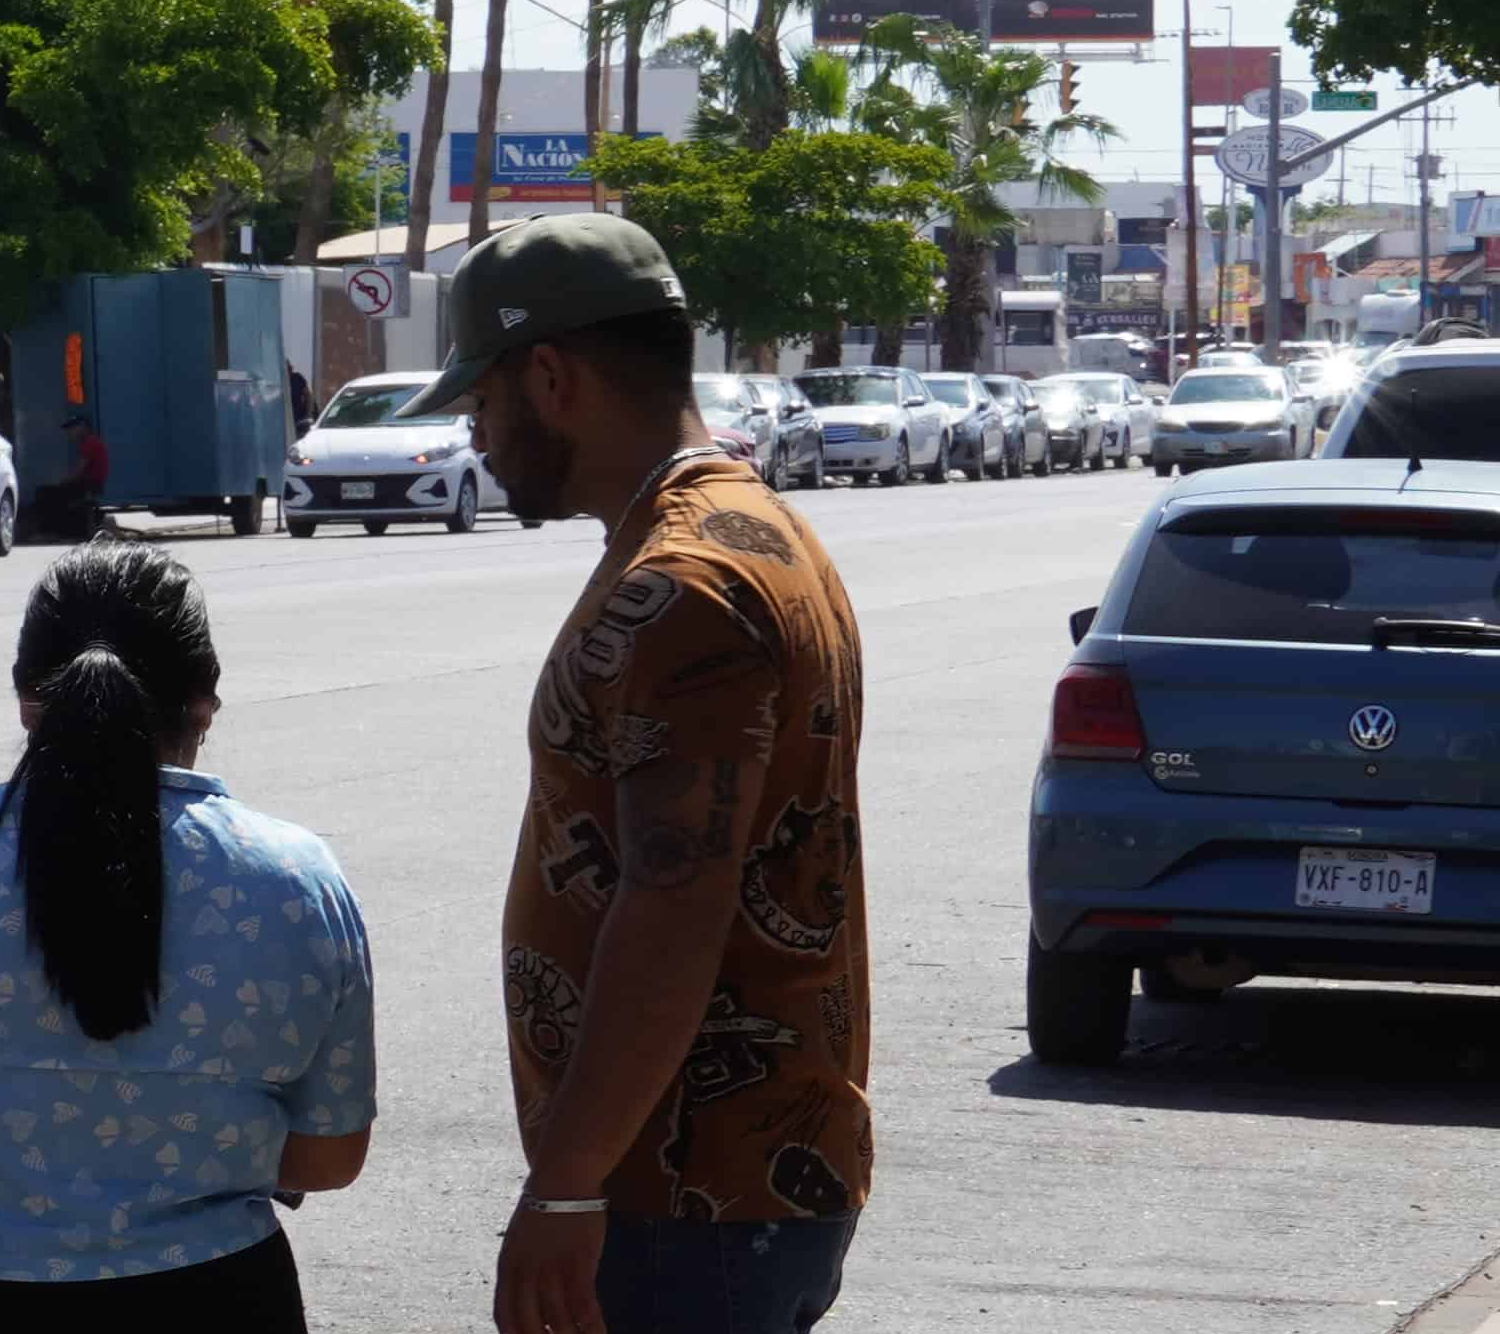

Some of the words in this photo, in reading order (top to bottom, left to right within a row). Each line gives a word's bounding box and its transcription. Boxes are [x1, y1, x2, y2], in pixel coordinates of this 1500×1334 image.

[545, 138, 569, 151] LA
[1149, 751, 1197, 765] GOL
[1303, 863, 1429, 896] VXF-810-A
